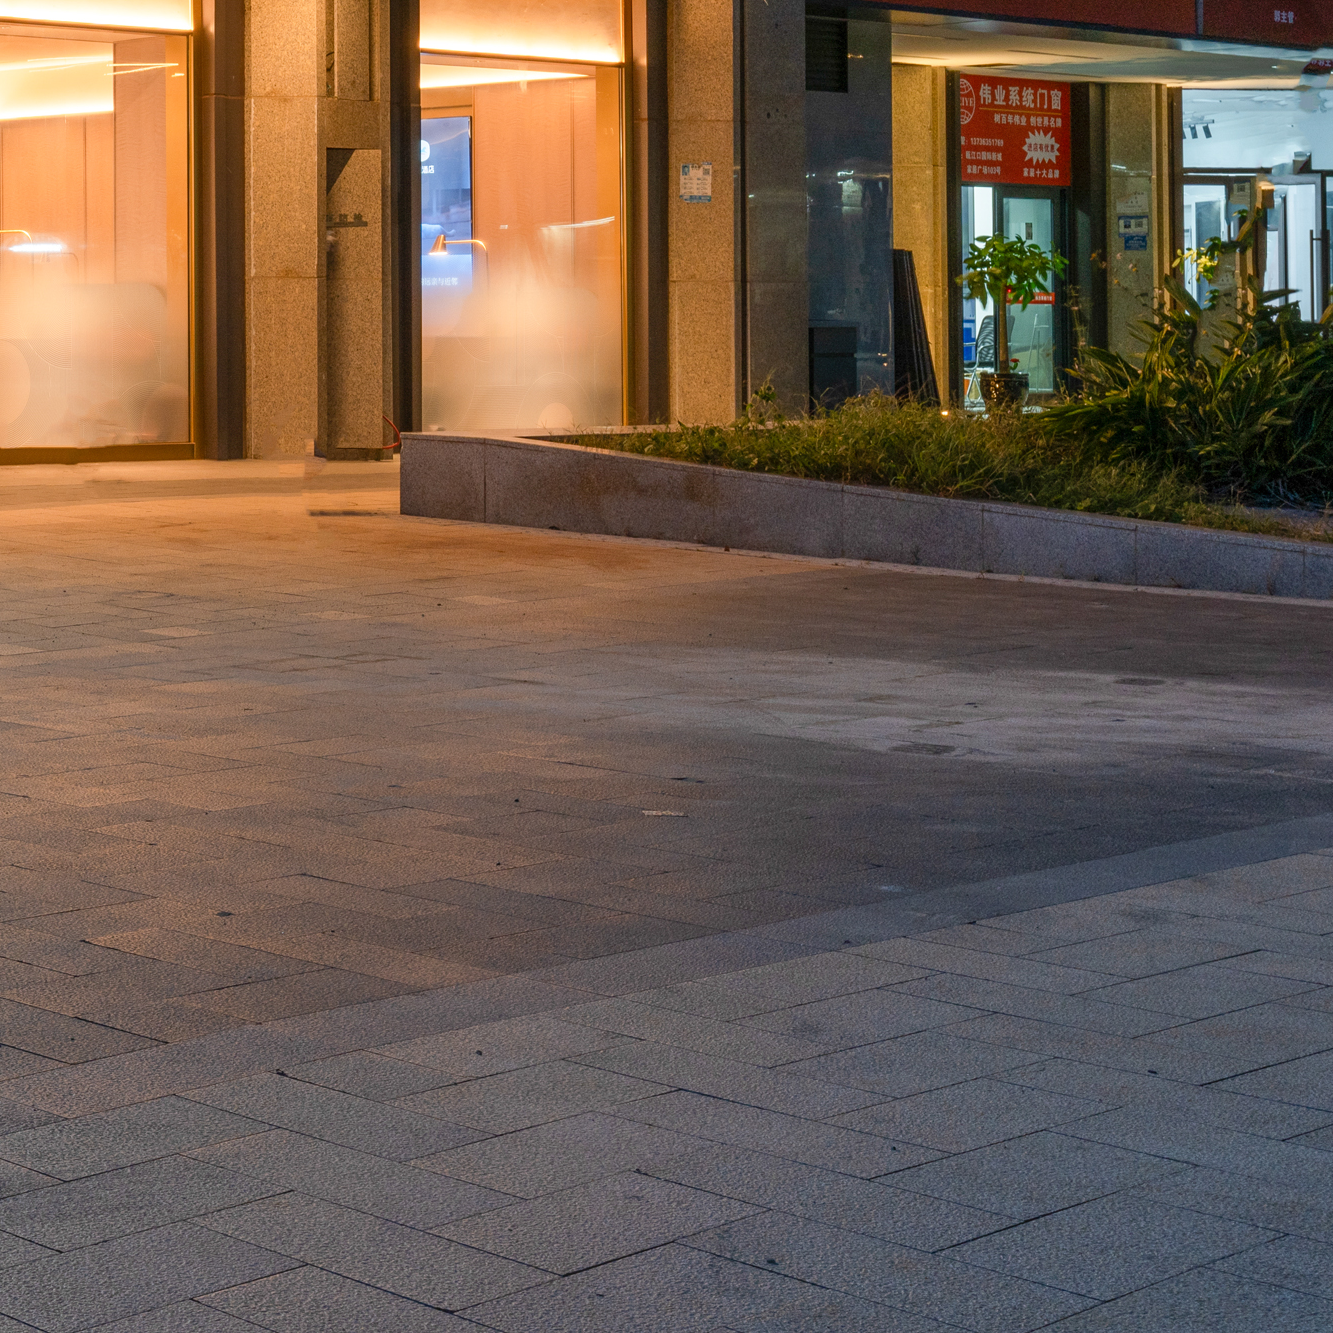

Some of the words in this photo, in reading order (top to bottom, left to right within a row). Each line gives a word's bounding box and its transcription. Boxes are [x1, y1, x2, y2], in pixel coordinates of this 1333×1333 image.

[979, 83, 1062, 110] 伟业系统门窗
[994, 113, 1027, 126] 树百年伟业
[1030, 116, 1062, 128] 创世界名牌
[1027, 143, 1055, 153] 进店有优惠
